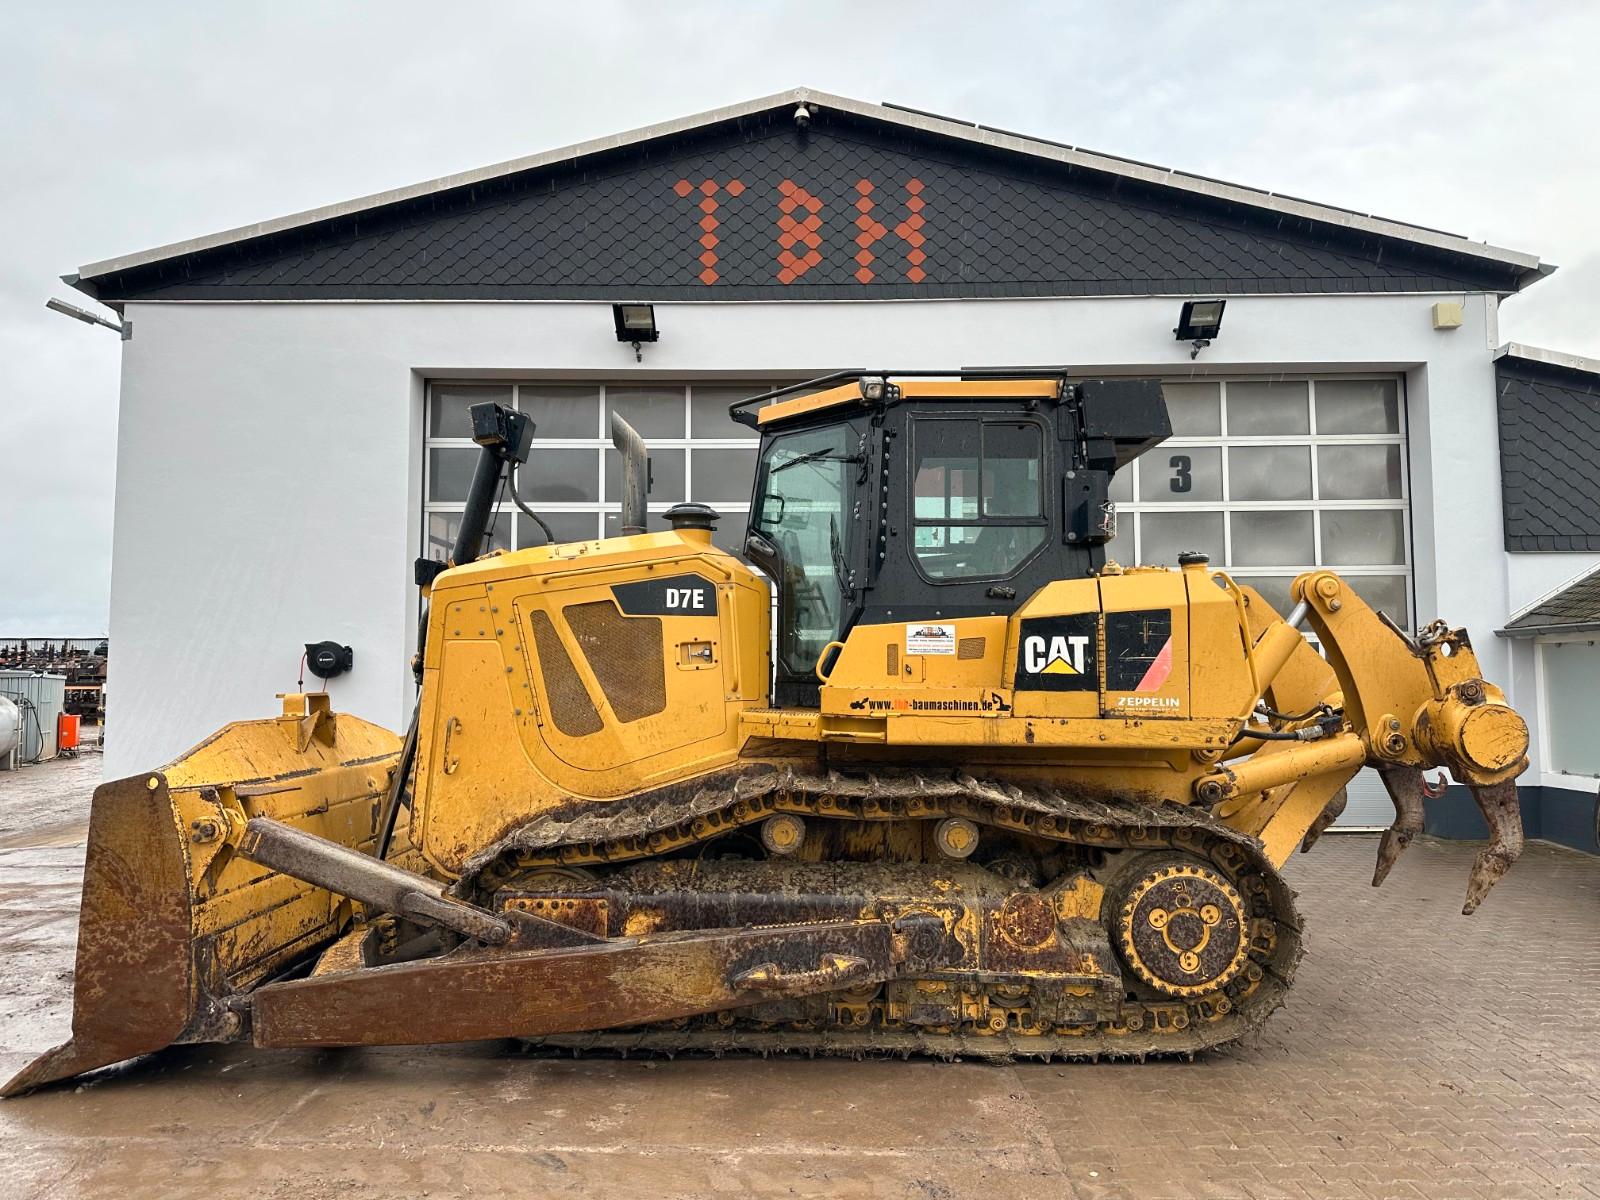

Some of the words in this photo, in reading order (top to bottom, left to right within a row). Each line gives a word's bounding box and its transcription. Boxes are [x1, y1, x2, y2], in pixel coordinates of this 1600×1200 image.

[1169, 455, 1192, 493] 3
[666, 588, 704, 609] D7E
[1024, 635, 1089, 675] CAT
[1117, 697, 1180, 707] ZEPPELIN
